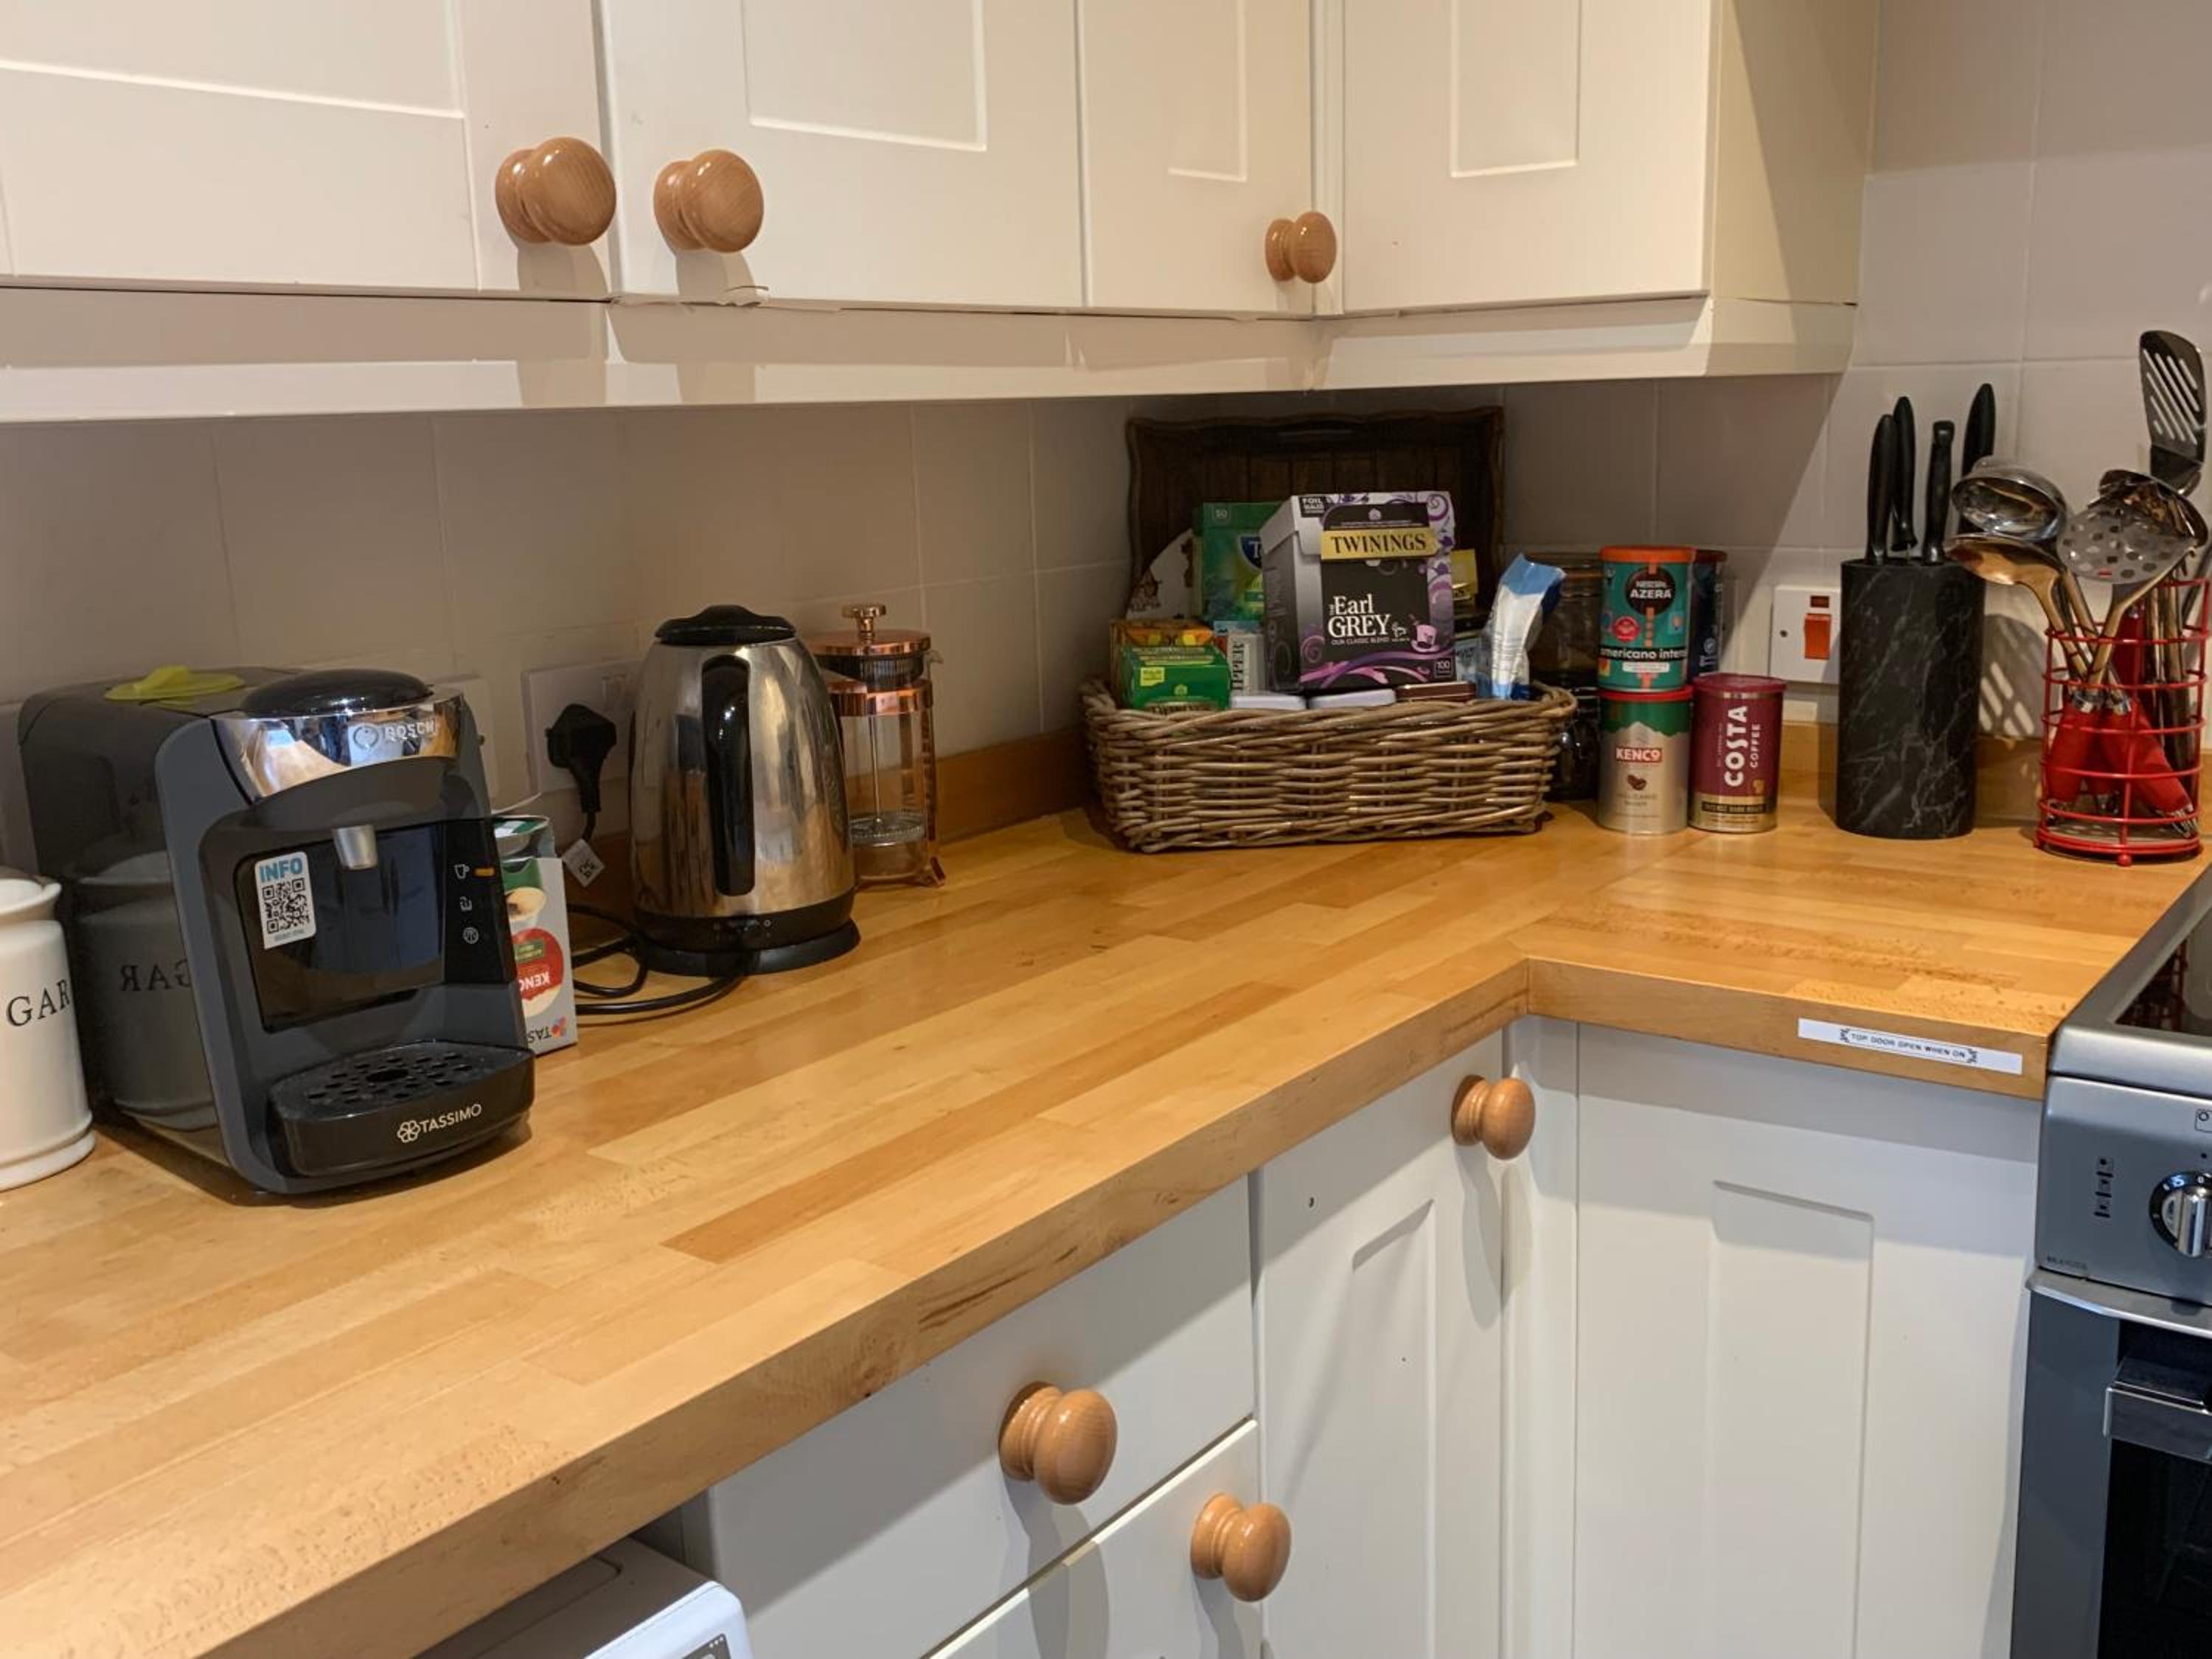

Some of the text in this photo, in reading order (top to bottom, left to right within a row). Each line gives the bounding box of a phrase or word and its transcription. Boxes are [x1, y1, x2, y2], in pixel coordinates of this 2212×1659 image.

[1330, 533, 1427, 554] TWININGS
[1334, 594, 1374, 616] Earl
[1630, 589, 1672, 599] AZERA
[1328, 613, 1391, 638] GREY
[1233, 642, 1244, 691] IPPER
[1437, 660, 1450, 669] 100
[385, 720, 436, 742] BOSCH
[1615, 747, 1660, 761] KENCO
[1724, 706, 1748, 787] COSTA
[1750, 723, 1761, 768] COFFEE
[260, 858, 303, 883] INFO
[518, 970, 551, 992] KENC
[6, 978, 71, 1027] GAR
[1851, 1033, 1965, 1057] TOP DOOR OPEN WHEN ON
[419, 1103, 481, 1133] TASSIMO
